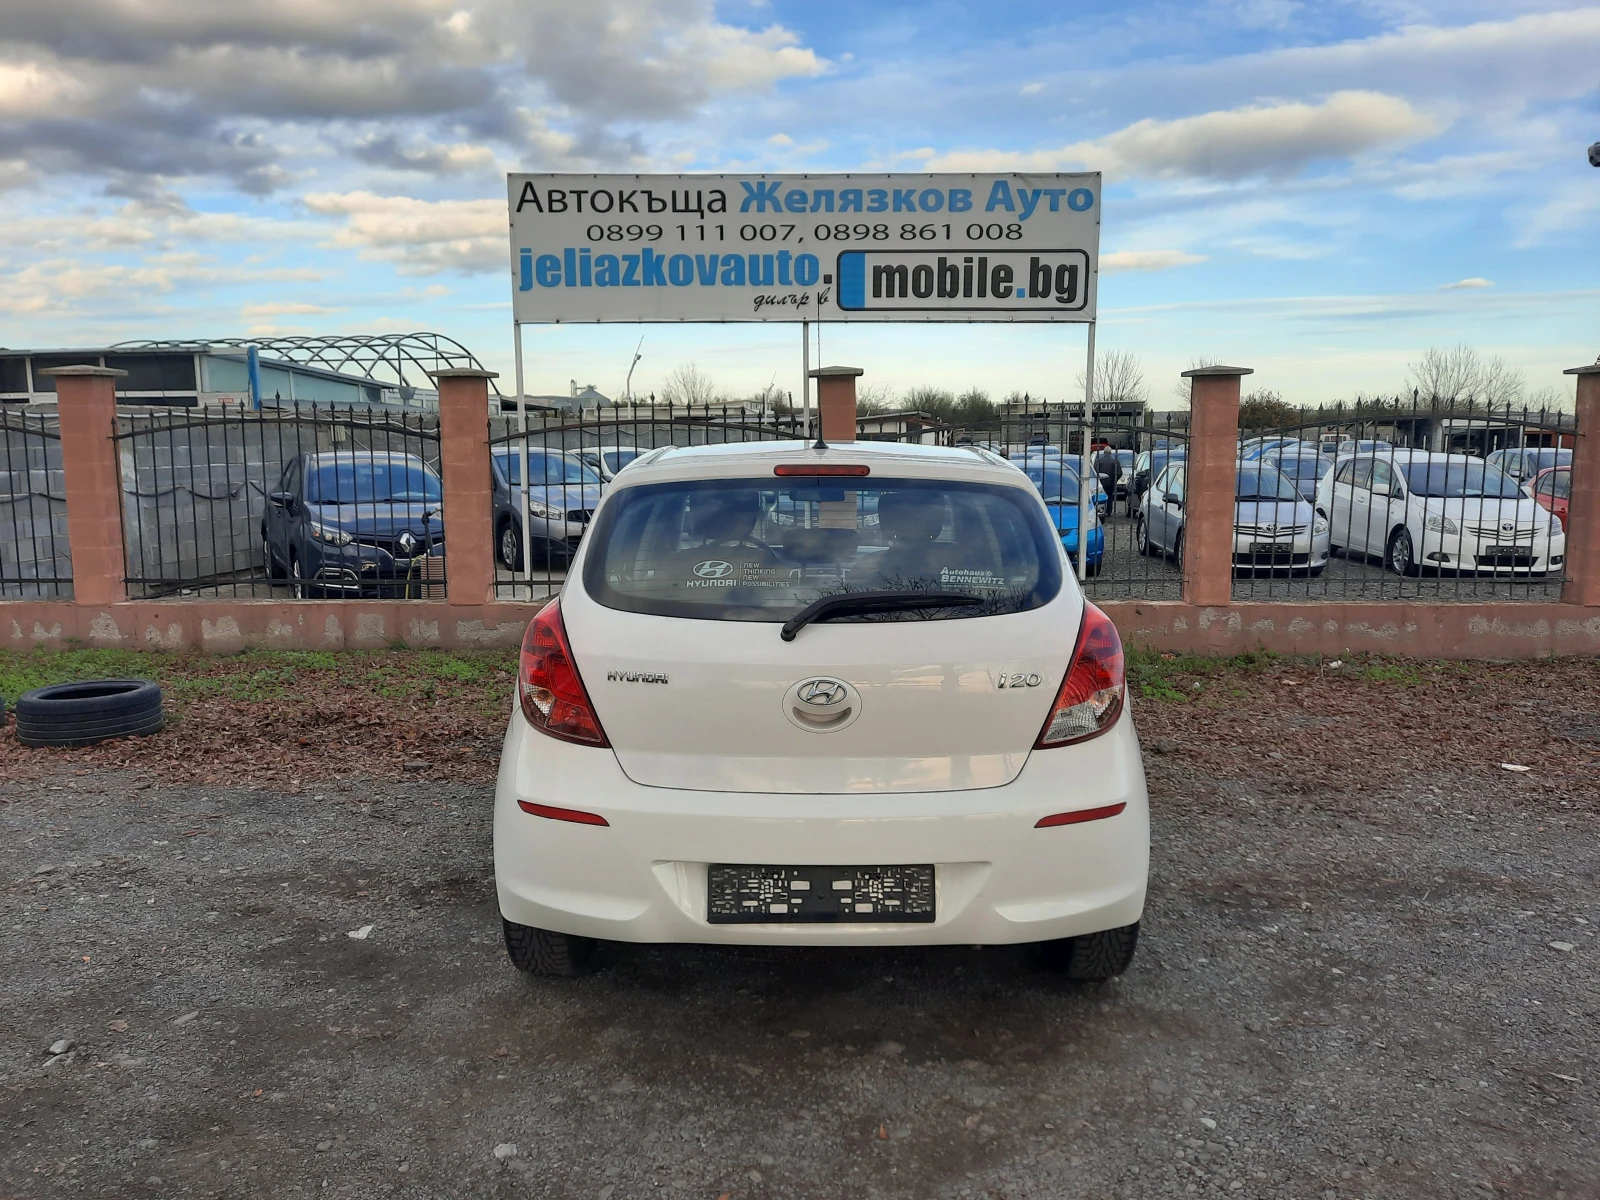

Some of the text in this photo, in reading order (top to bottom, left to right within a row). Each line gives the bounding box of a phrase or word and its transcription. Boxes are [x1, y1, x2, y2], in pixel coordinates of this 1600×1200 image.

[516, 179, 1095, 222] Автокъща Желязков Ауто
[586, 223, 1023, 243] 0899 111 007, 0898 861 008
[872, 256, 1079, 304] mobile.bg
[753, 292, 810, 312] дилър
[940, 566, 985, 576] Autohaus
[686, 579, 737, 588] HYUNDAI
[940, 575, 1005, 585] BENNEWITZ
[607, 670, 669, 685] HYUNDAI
[998, 672, 1042, 689] i20
